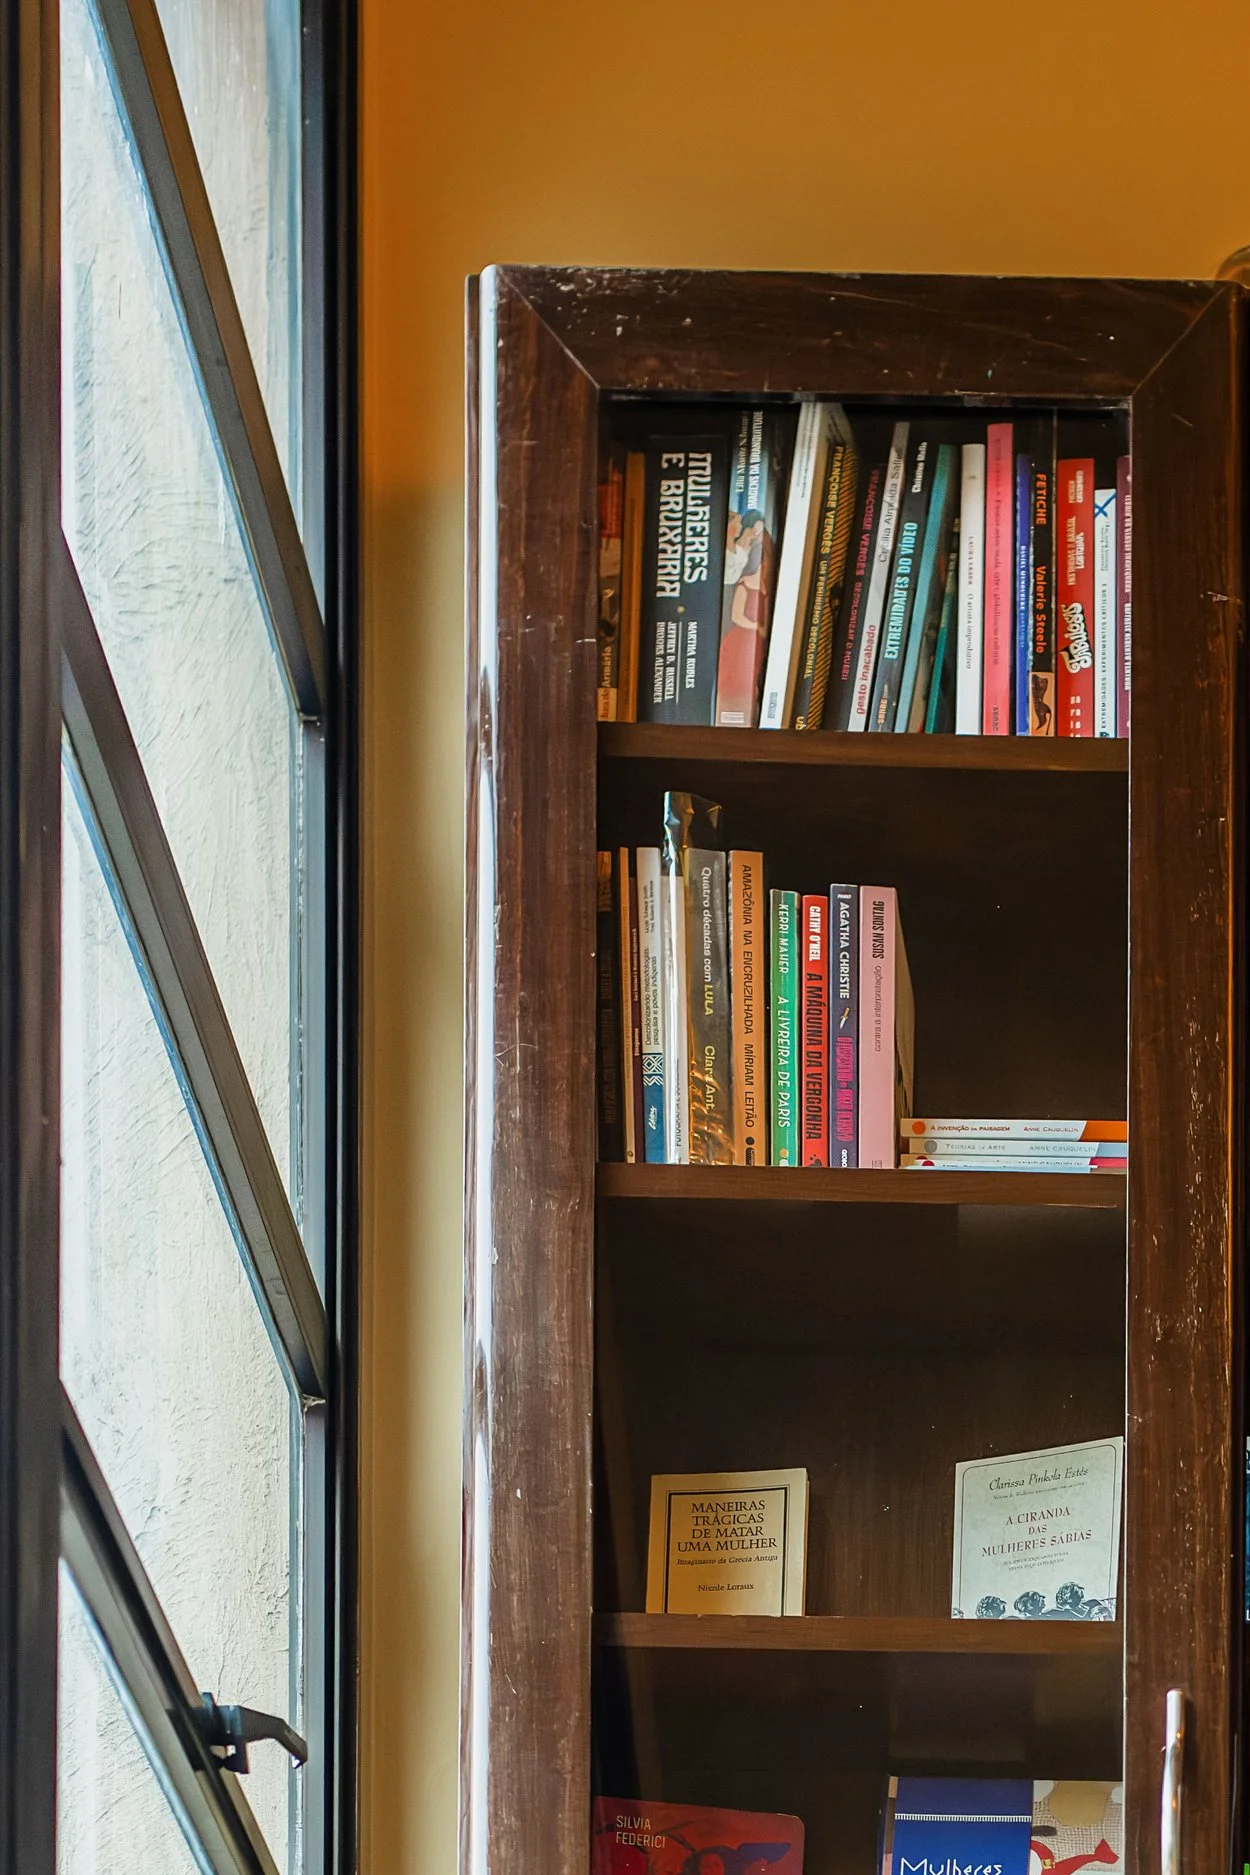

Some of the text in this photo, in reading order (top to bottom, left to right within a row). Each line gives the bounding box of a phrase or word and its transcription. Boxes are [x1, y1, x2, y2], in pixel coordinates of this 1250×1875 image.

[826, 446, 843, 508] FRANÇOISE
[656, 453, 684, 597] E BRUXARIA
[683, 452, 711, 583] MULHERES
[819, 560, 827, 574] UM
[1035, 474, 1047, 653] FETICHE Valerie Steele
[811, 576, 825, 624] FEMINISMO
[884, 522, 918, 660] EXTREMIDADES DO VÍDEO
[804, 626, 819, 679] DECOLONIAL
[855, 625, 876, 715] gesto inacabado
[701, 867, 715, 1015] Quatro décadas com LULA
[839, 902, 850, 999] AGATHA CHRISTIE
[872, 901, 885, 959] SUSAN SONTAG
[742, 864, 758, 1128] AMAZÔNIA NA ENCRUZILHADA MÍRIAM LEITÃO
[777, 903, 790, 1128] KERRI MAHER A LIVREIRA DE PARIS
[805, 906, 827, 1139] CATHY O'NEIL A MÁQUINA DA VERGONHA
[989, 1478, 1025, 1491] Clarissa
[1029, 1468, 1061, 1485] Pinkola
[1065, 1467, 1088, 1479] Estés
[691, 1500, 765, 1513] MANEIRAS
[692, 1512, 764, 1526] TRÁGICAS
[1006, 1506, 1070, 1525] A CIRANDA
[1028, 1524, 1047, 1535] DAS
[677, 1538, 777, 1552] UMA MULHER
[692, 1526, 764, 1538] DE MATAR
[982, 1530, 1092, 1557] MULHERES SÁBIAS
[698, 1584, 724, 1592] Nicole
[616, 1815, 651, 1830] SILVIA
[616, 1832, 666, 1848] FEDERICI
